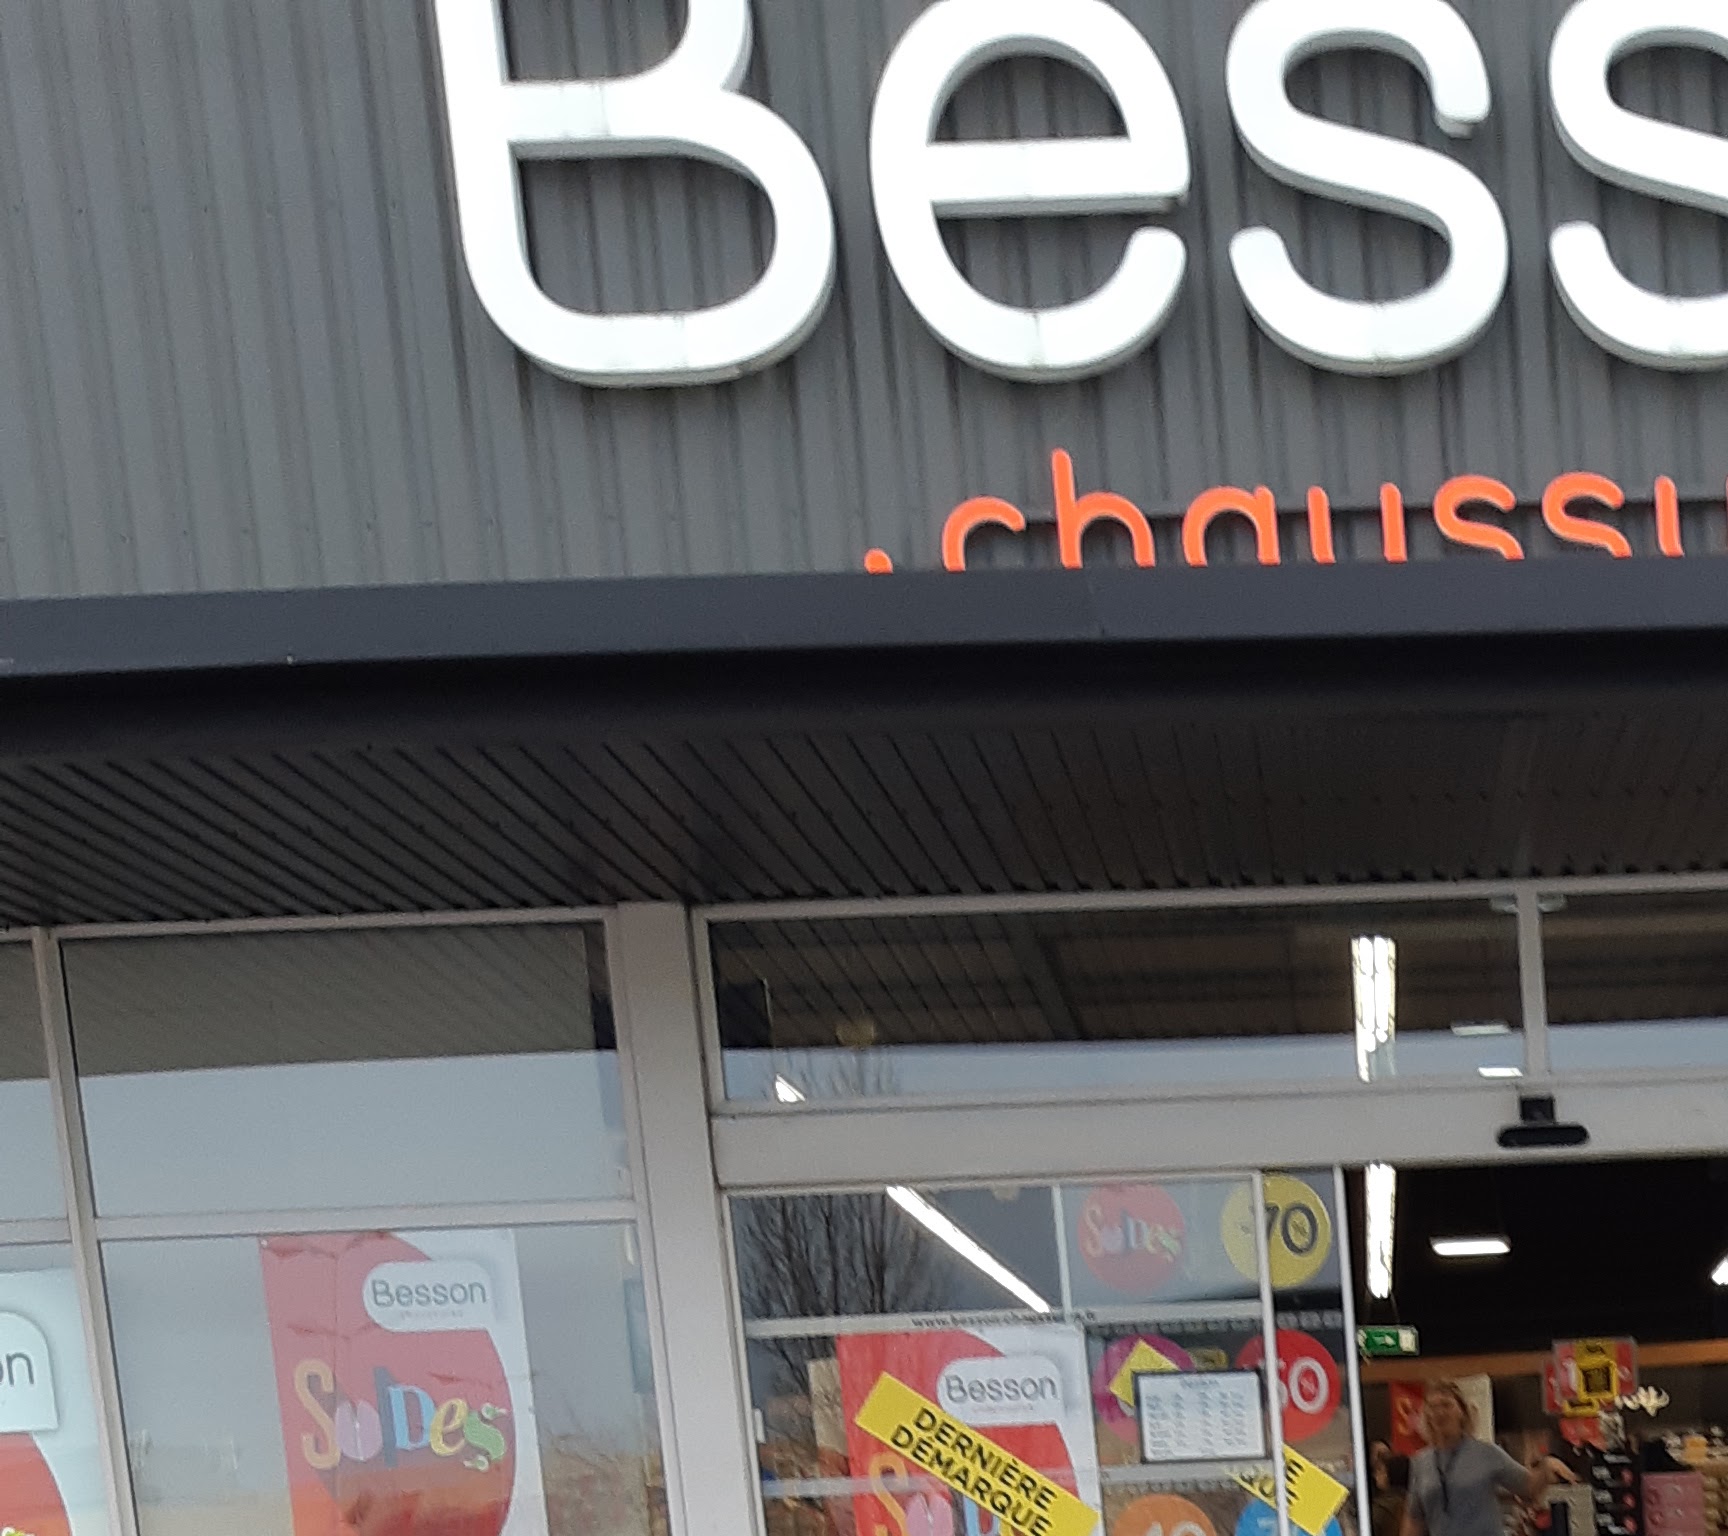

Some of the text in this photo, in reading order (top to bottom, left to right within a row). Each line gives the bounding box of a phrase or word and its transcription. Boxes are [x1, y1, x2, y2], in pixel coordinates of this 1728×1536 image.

[372, 1279, 487, 1306] Besson
[945, 1374, 1058, 1404] Besson
[912, 1407, 1058, 1512] DERNIÈRE
